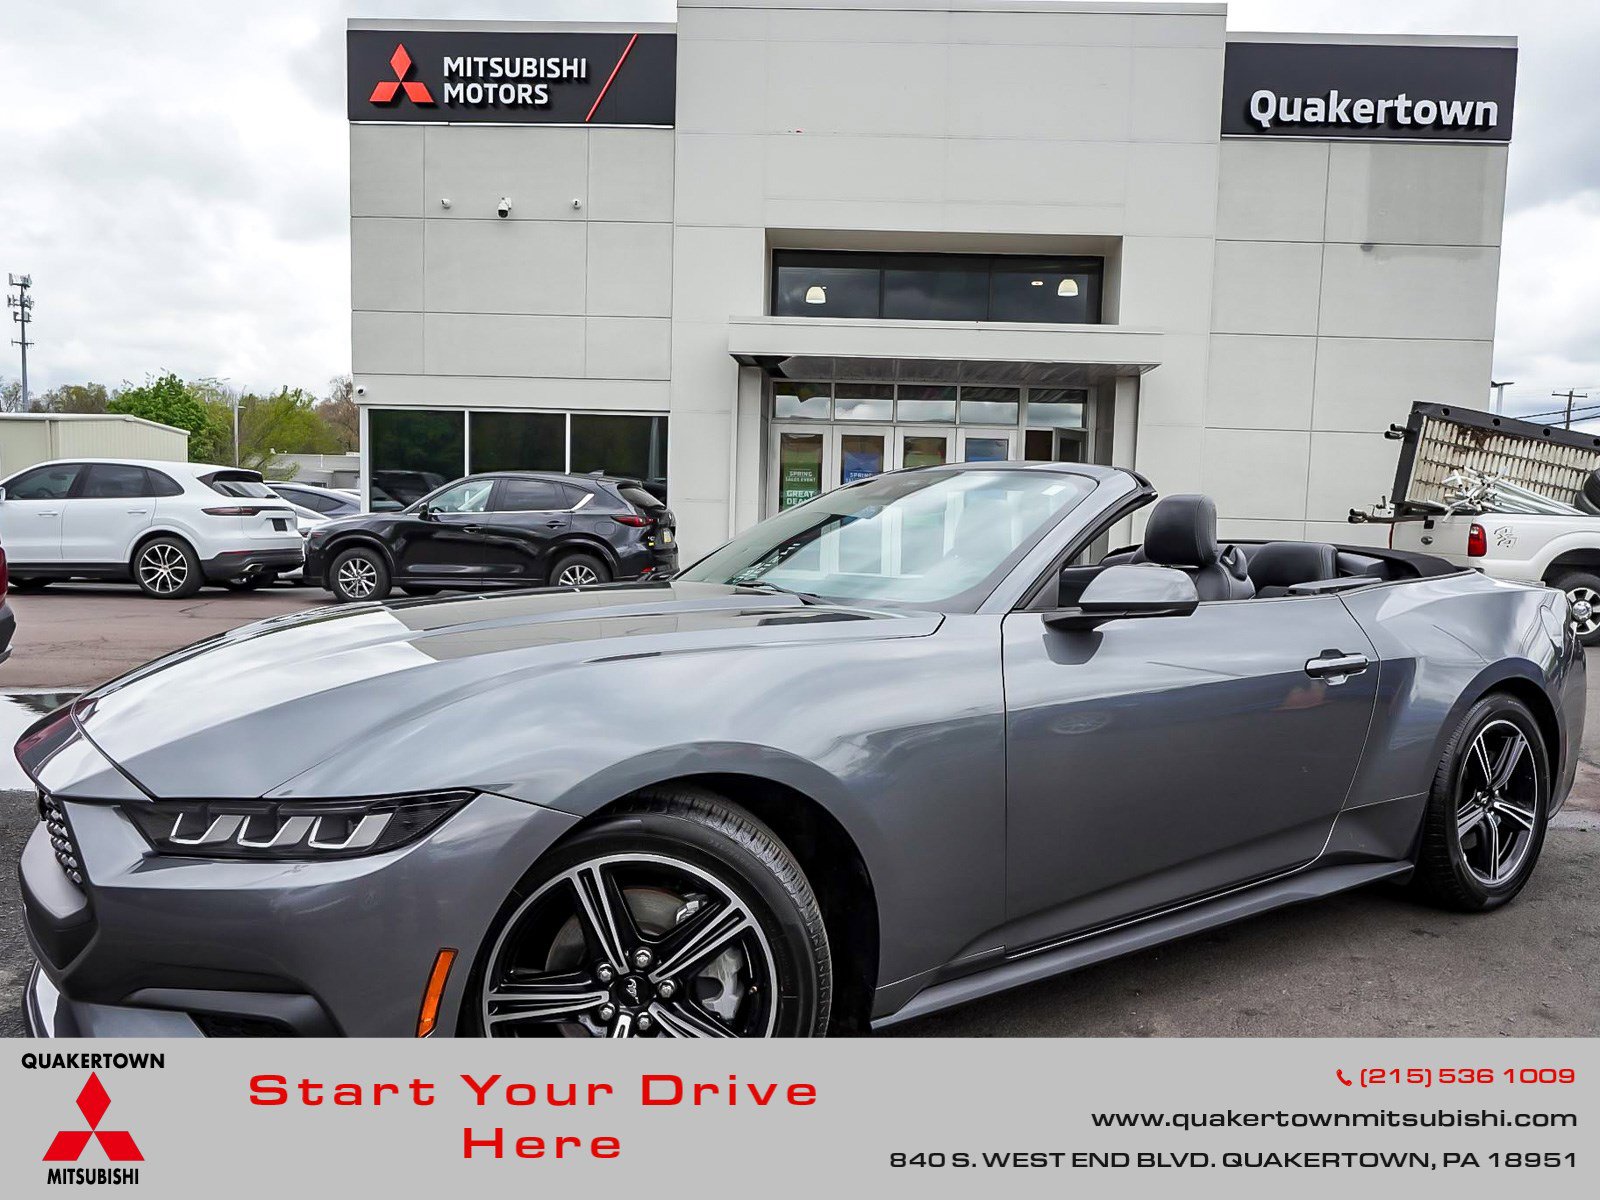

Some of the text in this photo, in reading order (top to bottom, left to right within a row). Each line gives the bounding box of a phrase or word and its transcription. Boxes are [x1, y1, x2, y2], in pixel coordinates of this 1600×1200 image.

[443, 56, 587, 79] MITSUBISHI
[443, 82, 549, 105] MOTORS
[1250, 89, 1499, 128] Quakertown
[786, 489, 815, 498] GREAT
[786, 497, 807, 505] DEA
